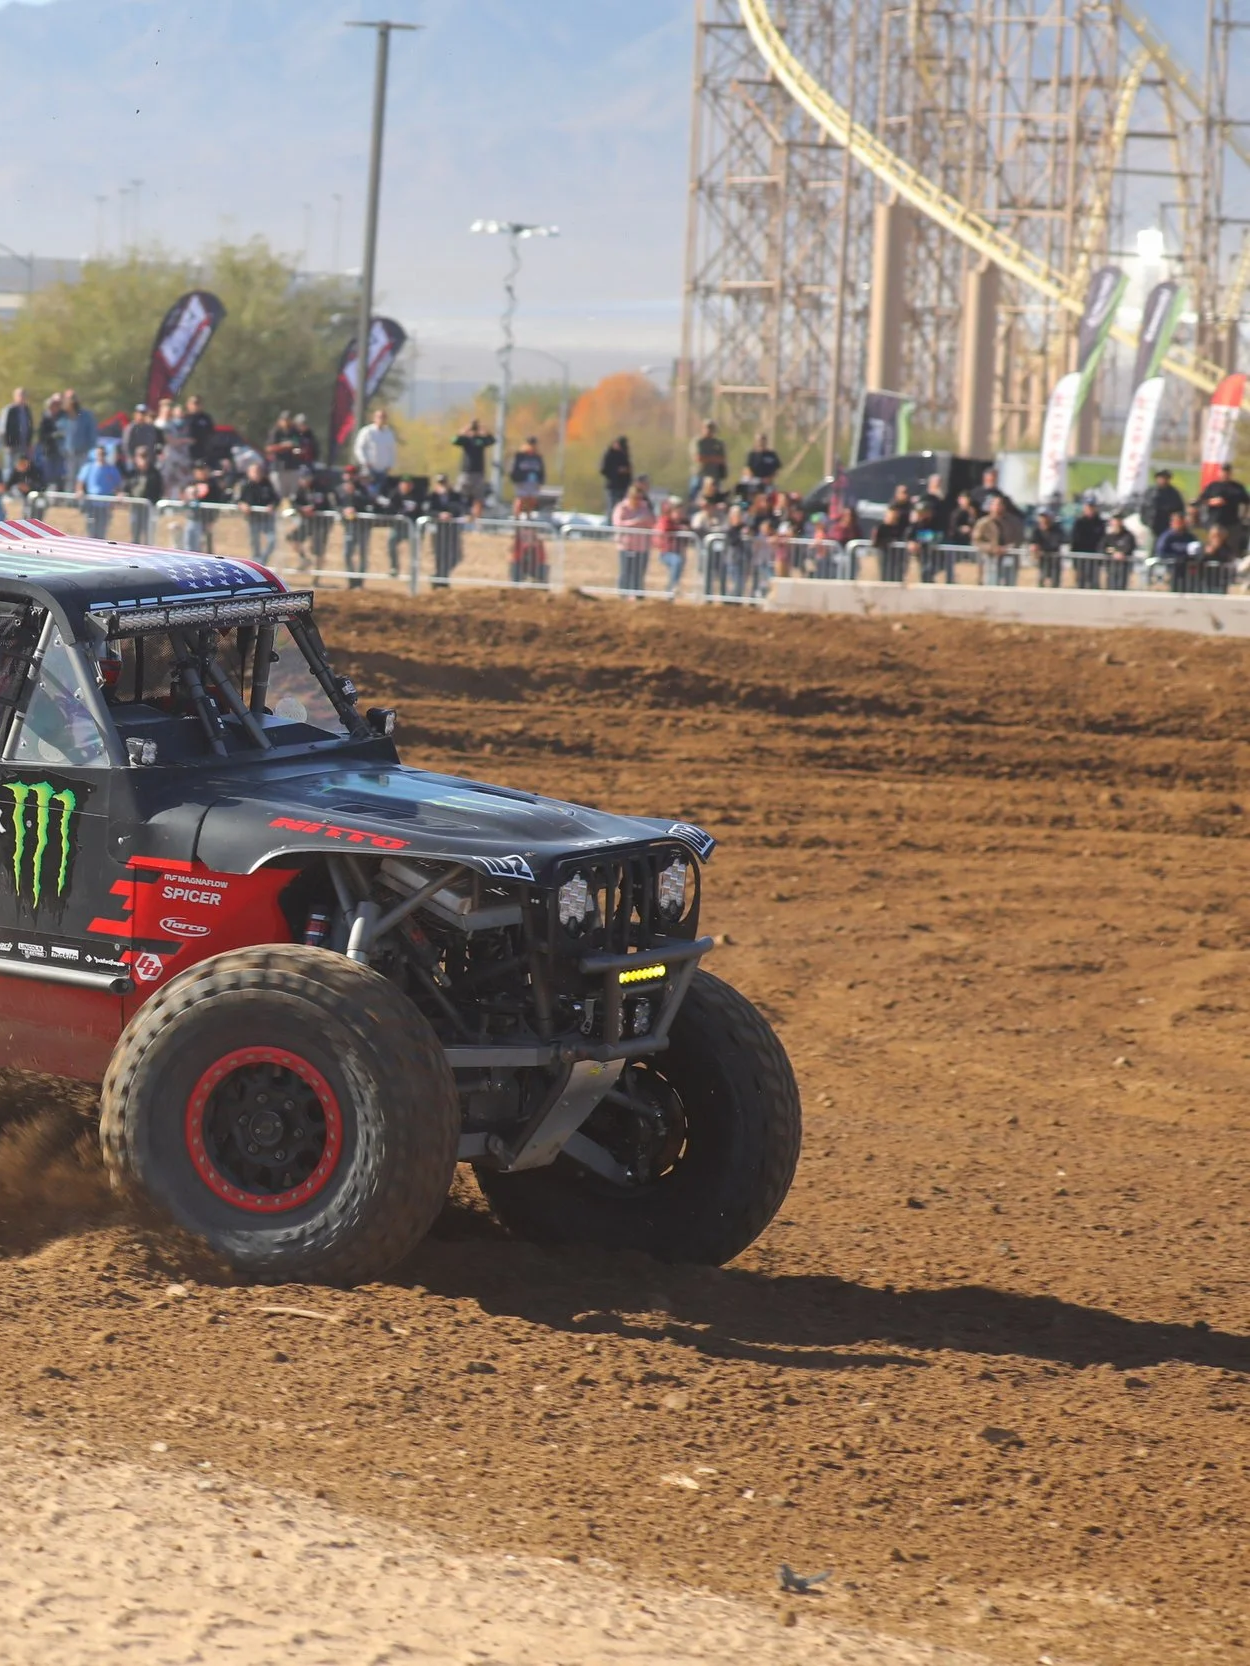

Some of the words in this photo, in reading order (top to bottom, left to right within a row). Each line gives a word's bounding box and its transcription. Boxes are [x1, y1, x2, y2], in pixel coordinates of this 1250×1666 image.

[268, 817, 411, 849] NITTO
[162, 886, 221, 906] SPICER
[166, 919, 207, 933] Torco
